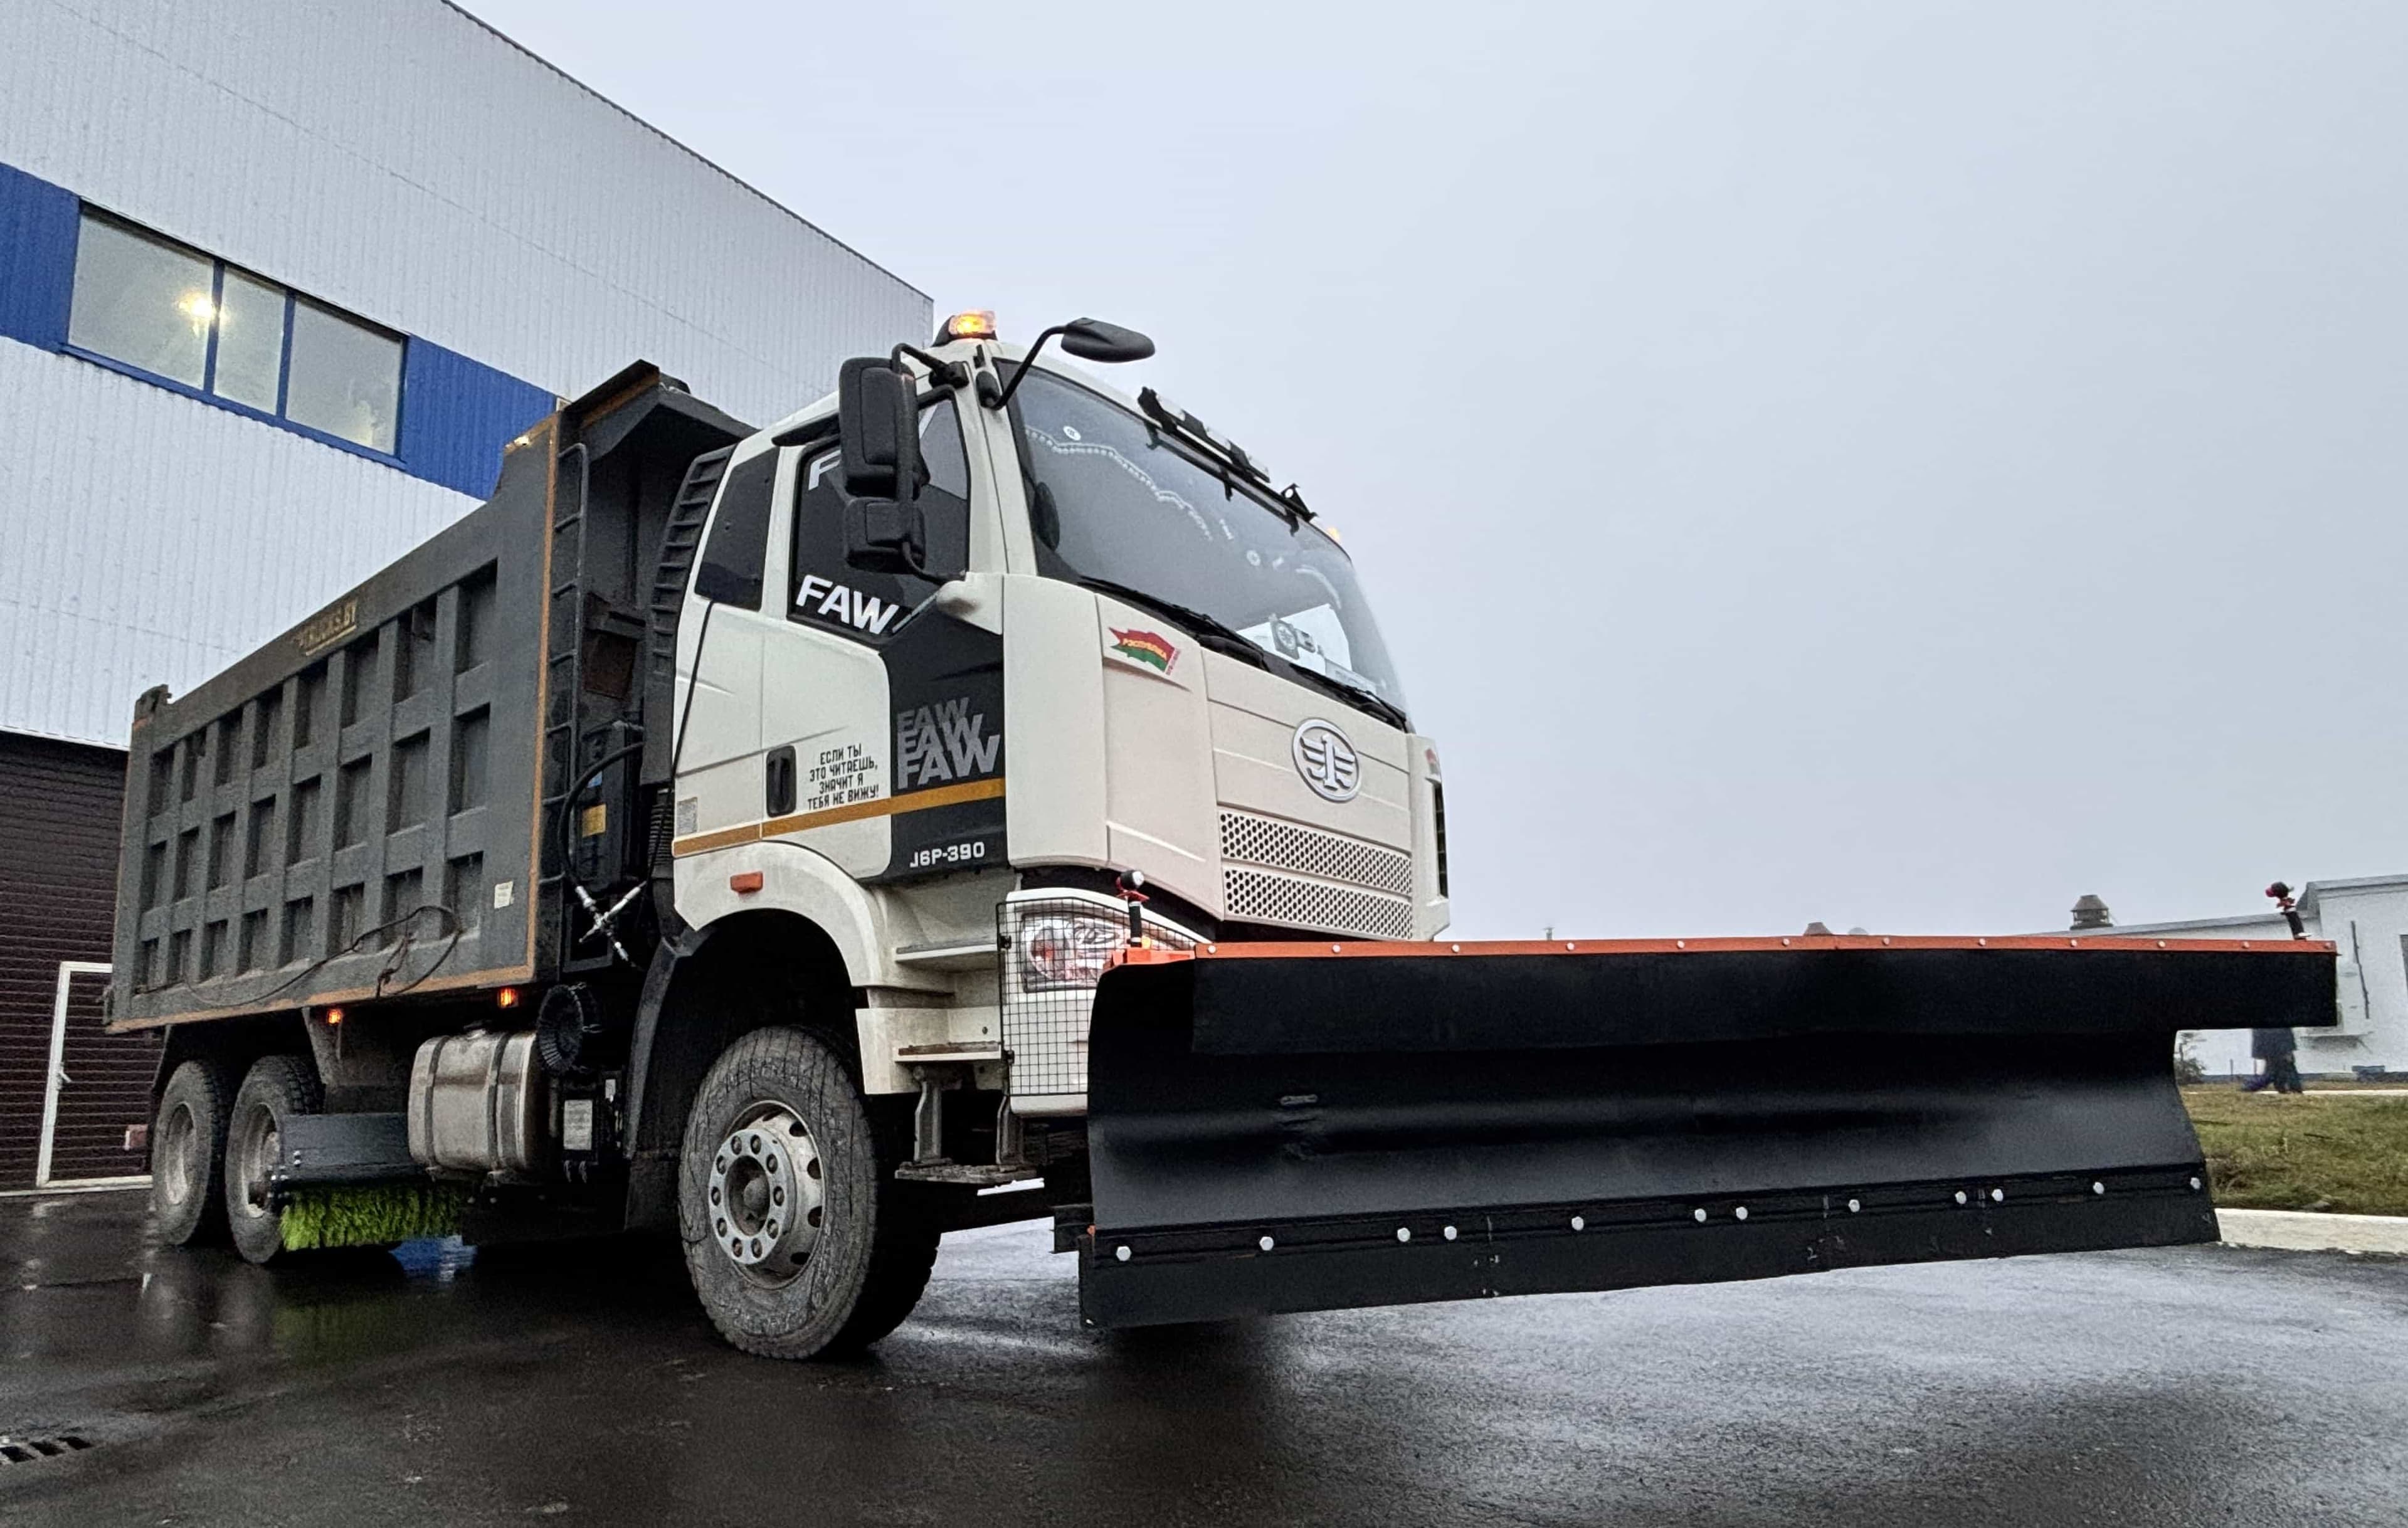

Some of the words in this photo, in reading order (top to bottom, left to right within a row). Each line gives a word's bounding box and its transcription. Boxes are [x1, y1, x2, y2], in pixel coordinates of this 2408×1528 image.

[796, 574, 899, 635] FAW
[820, 748, 843, 765] ЕСЛИ
[848, 743, 862, 759] ТЫ
[897, 734, 1000, 789] FAW
[810, 767, 826, 782] ЭТО
[819, 774, 853, 794] ЗНАЧИТ
[857, 772, 863, 786] Я
[808, 794, 830, 810] ТЕБЯ
[833, 791, 844, 804] НЕ
[848, 784, 879, 802] ВИЖУ!
[909, 841, 985, 868] J6P-390
